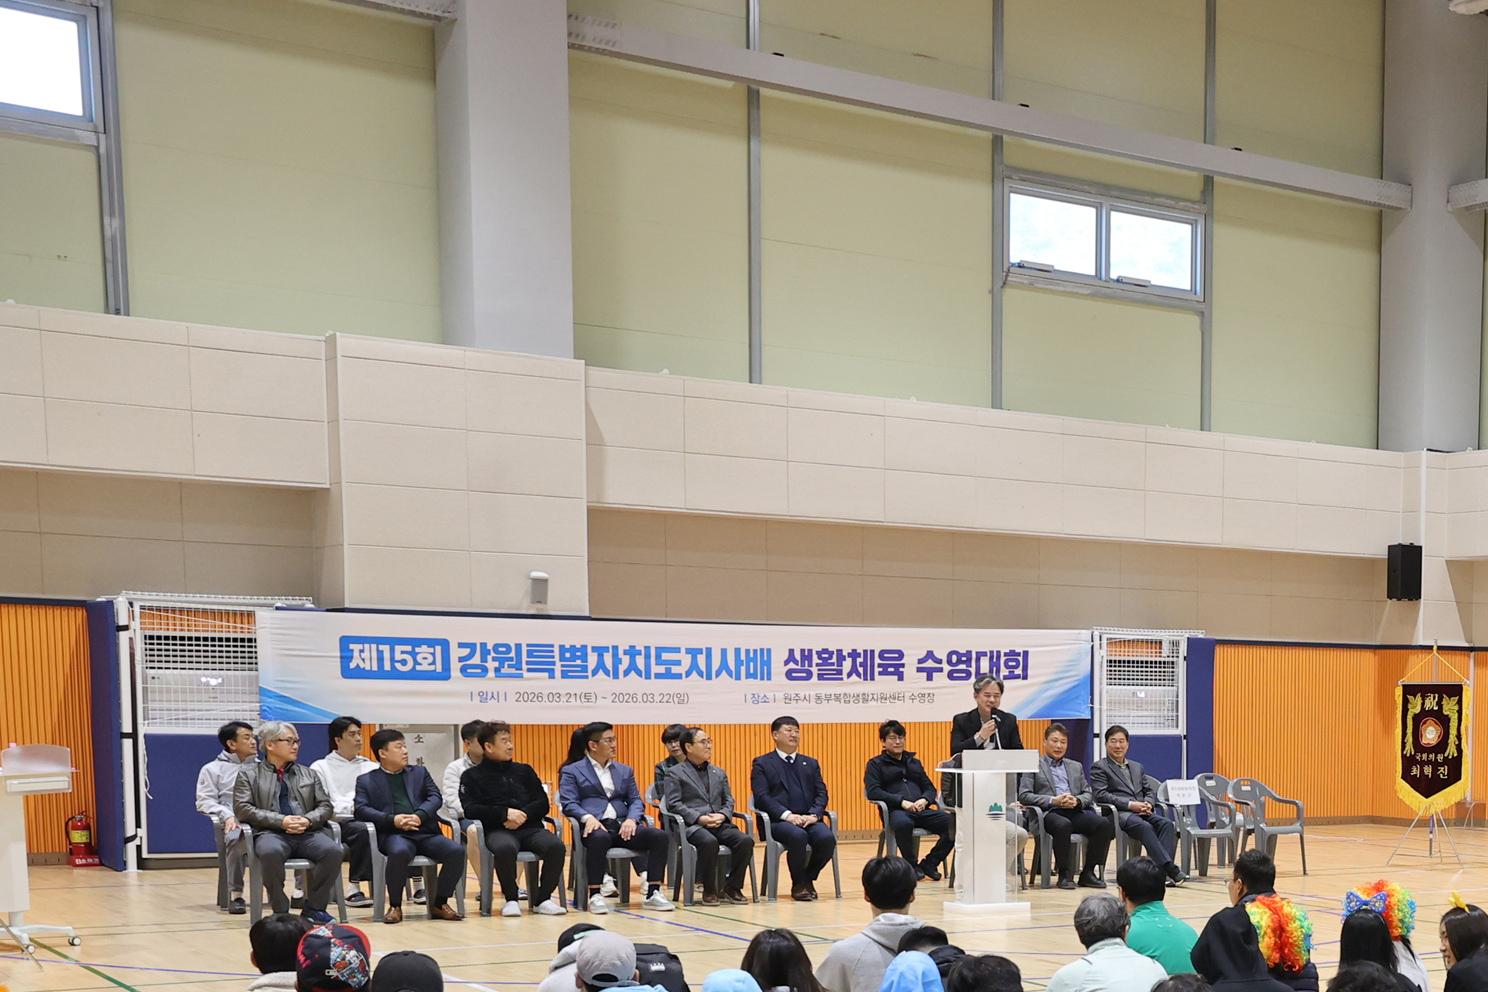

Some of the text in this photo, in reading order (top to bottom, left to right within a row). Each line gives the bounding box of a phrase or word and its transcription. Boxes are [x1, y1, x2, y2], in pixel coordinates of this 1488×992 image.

[349, 641, 1029, 682] 제15회 강원특별자치도지사배 생활체육 수영대회
[515, 691, 597, 705] 2026.03.21(토)
[611, 692, 690, 705] 2026.03.22(일)
[783, 692, 811, 705] 원주시
[814, 692, 906, 705] 동부복합생활지원센터
[908, 692, 935, 704] 수영장
[1415, 752, 1444, 763] 국회의원
